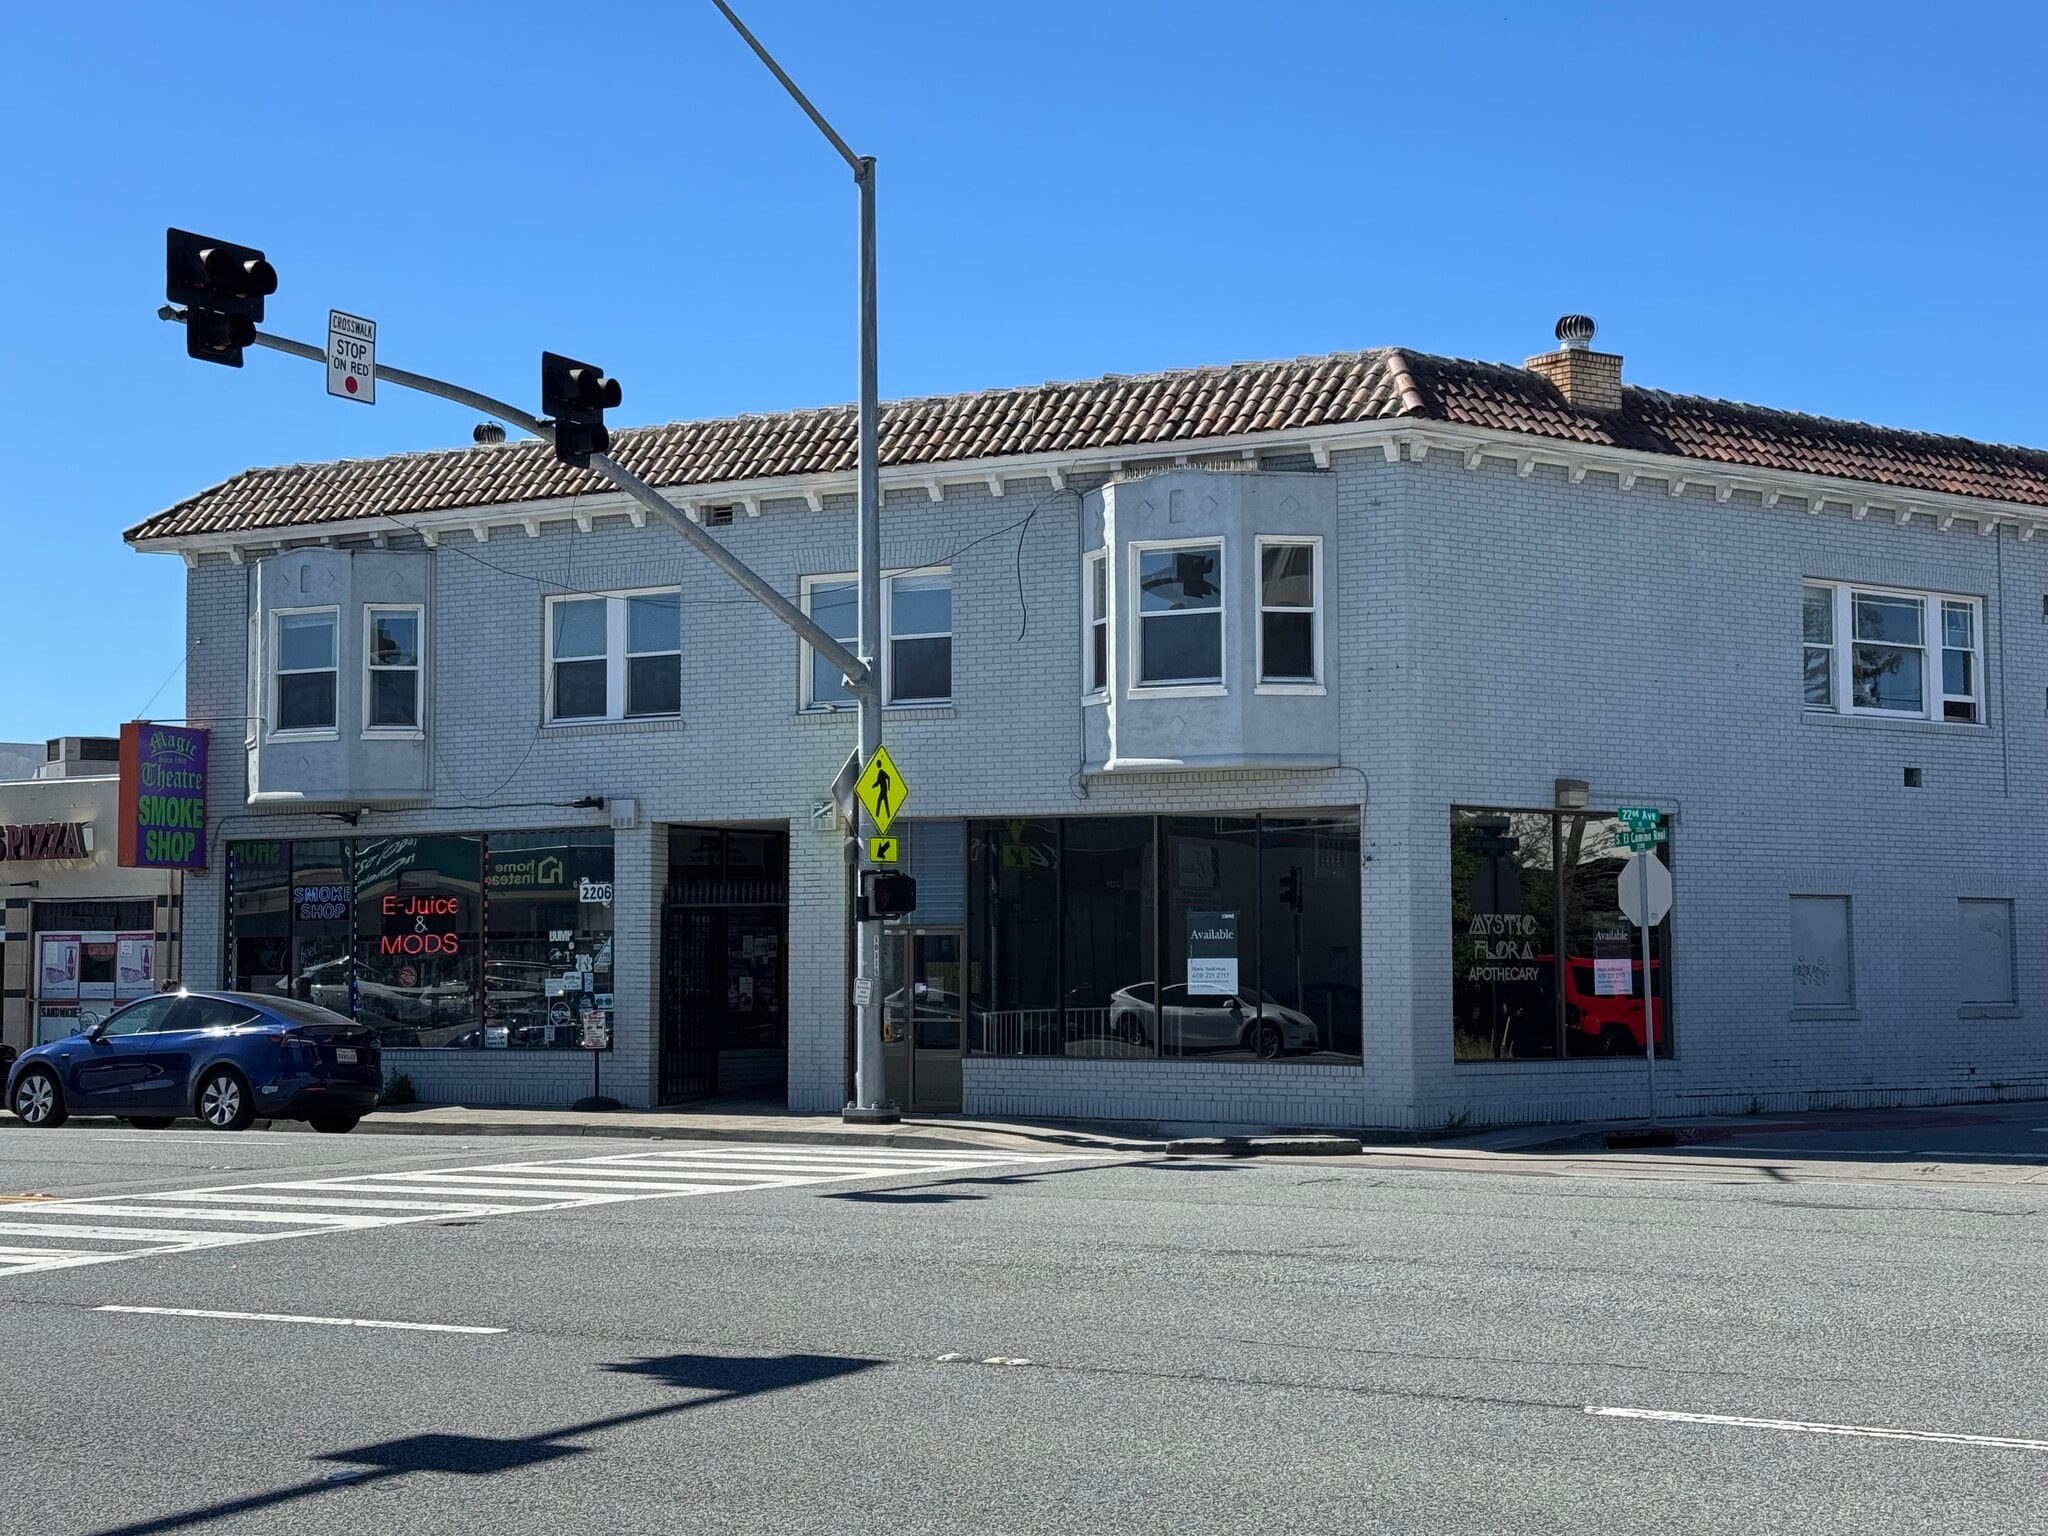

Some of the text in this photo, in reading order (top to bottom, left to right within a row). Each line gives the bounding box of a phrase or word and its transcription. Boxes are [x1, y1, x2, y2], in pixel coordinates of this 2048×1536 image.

[333, 315, 373, 338] CROSSWALK
[336, 338, 367, 360] STOP
[150, 731, 198, 756] Magic
[140, 762, 202, 792] Theatre
[138, 795, 204, 828] SMOKE
[1622, 810, 1656, 821] 22nd Ave
[6, 823, 86, 862] PIZZA
[145, 830, 195, 862] SHOP
[1624, 834, 1629, 844] El
[1630, 832, 1652, 843] Camino
[1653, 830, 1666, 840] Real
[294, 886, 350, 903] SMOKE
[582, 885, 612, 900] 2206
[300, 903, 345, 919] SHOP
[382, 896, 459, 915] E-Juice
[414, 915, 428, 933] &
[1468, 914, 1537, 935] MYSTIC
[1190, 928, 1234, 940] Available
[1596, 930, 1628, 941] Available
[88, 944, 115, 955] OPEN
[380, 933, 459, 955] MODS
[1474, 940, 1534, 960] FLORA
[1468, 966, 1539, 981] APOTHECARY
